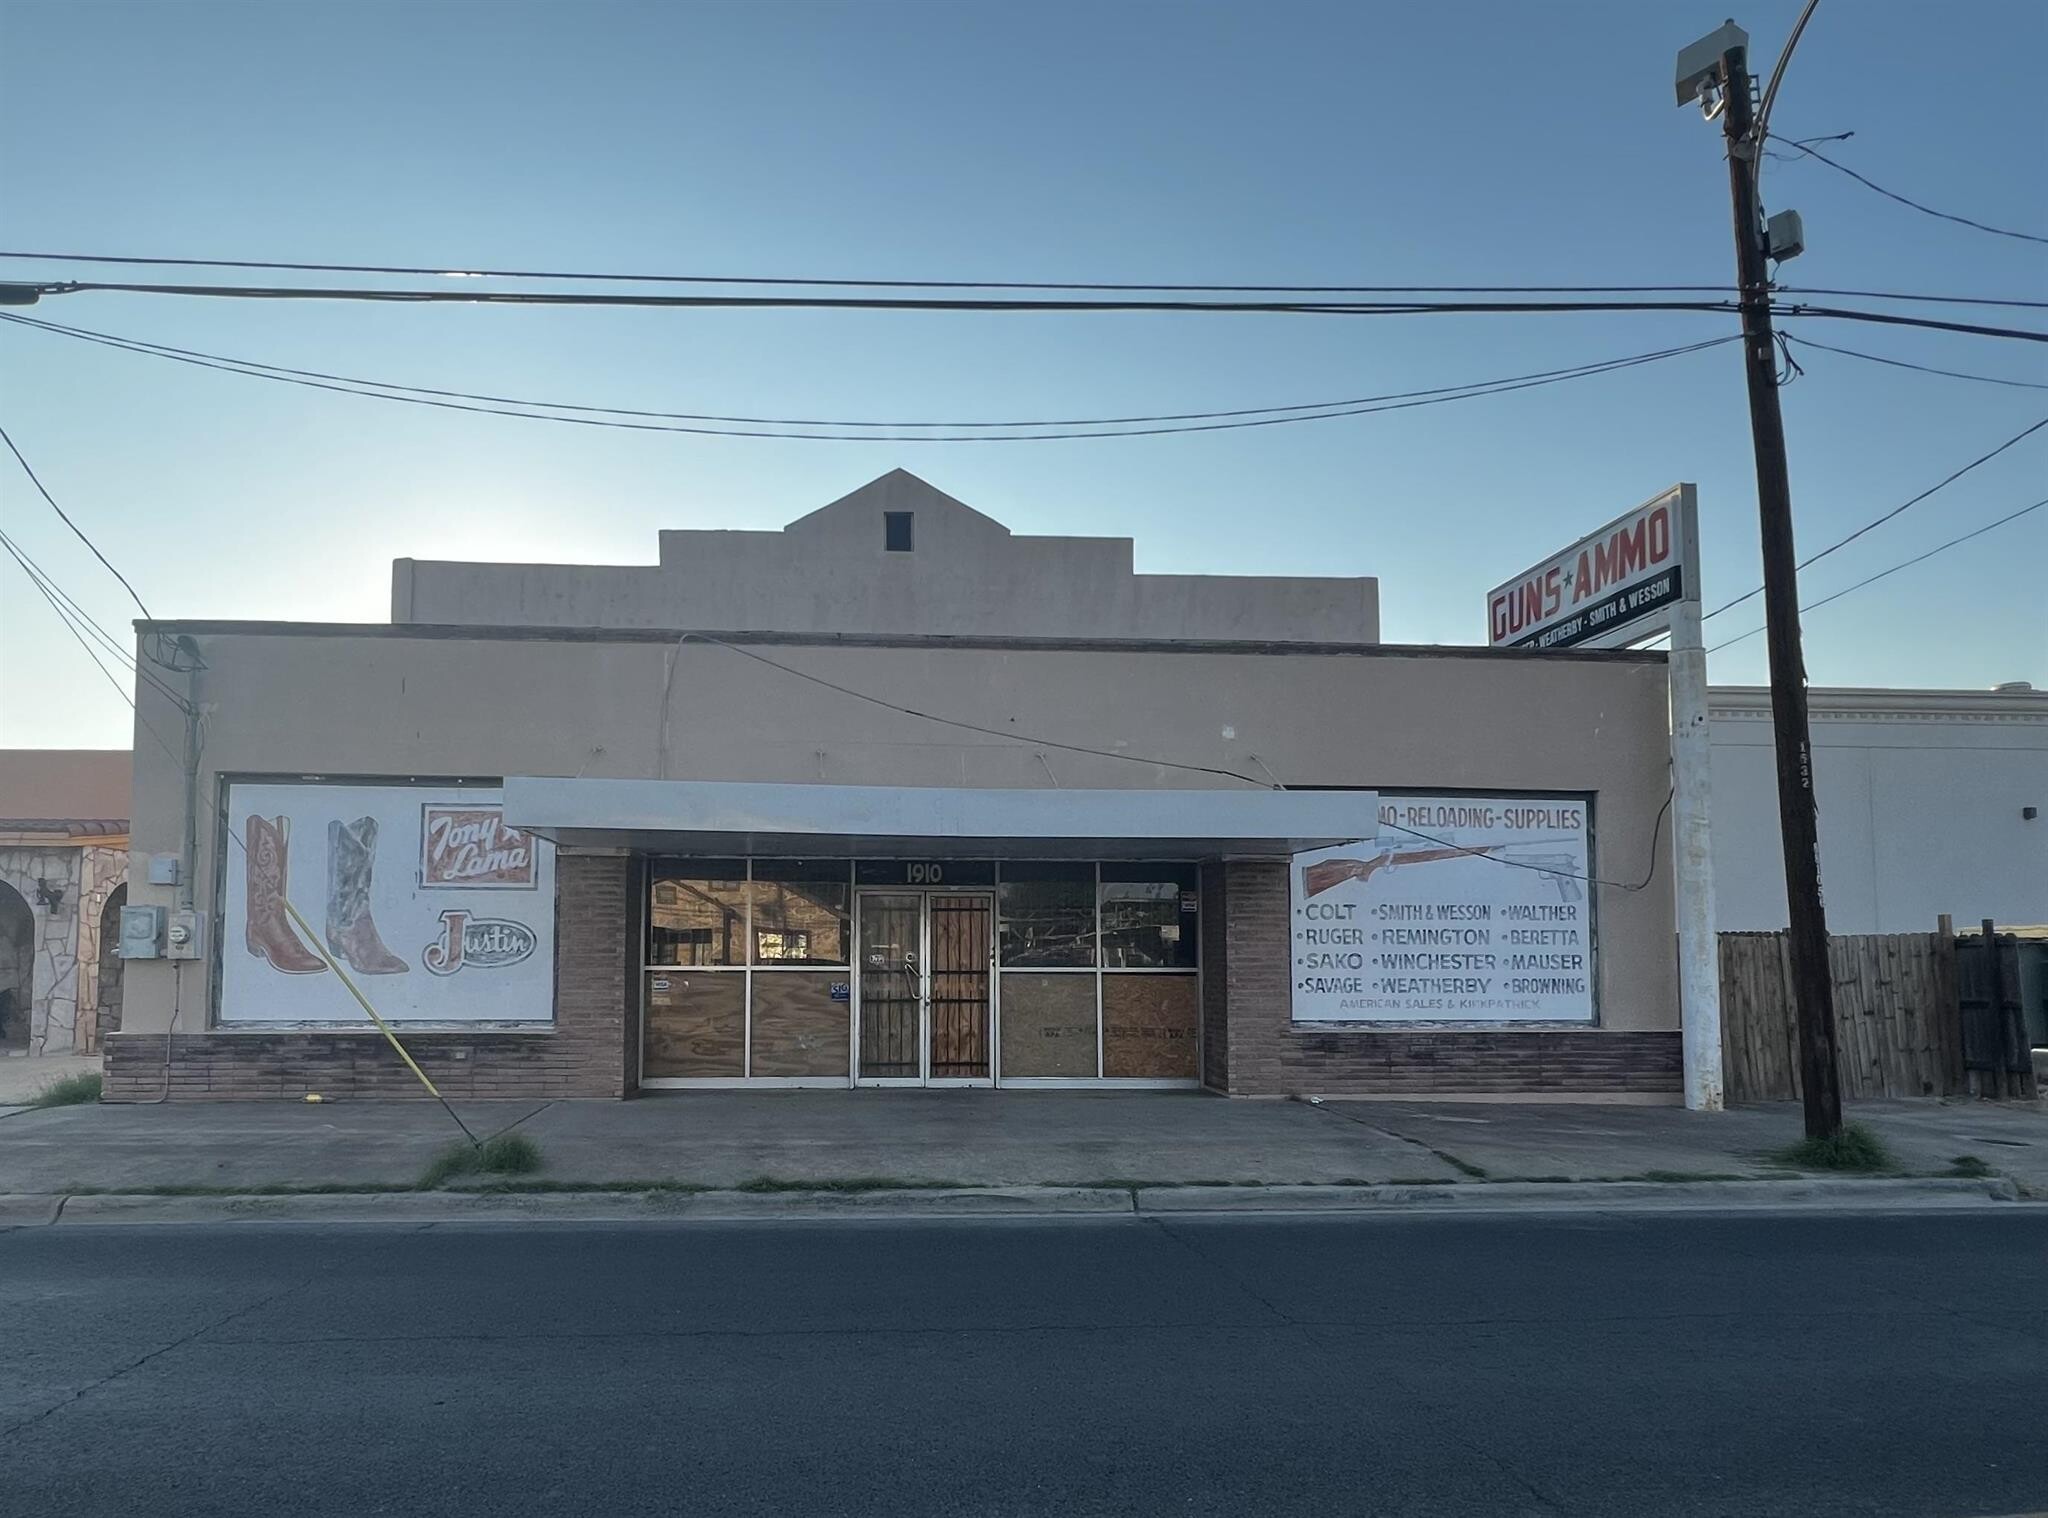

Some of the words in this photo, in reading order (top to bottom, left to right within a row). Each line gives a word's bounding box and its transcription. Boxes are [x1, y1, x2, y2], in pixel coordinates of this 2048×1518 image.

[1492, 566, 1561, 642] GUNS
[1572, 507, 1669, 604] AMMO
[1539, 616, 1583, 648] WEATHERBY
[1589, 601, 1617, 626] SMITH
[1618, 597, 1627, 613] &
[1628, 577, 1670, 609] WESSON
[430, 816, 499, 865] Tony
[443, 843, 529, 880] Lama
[907, 863, 942, 883] 1910
[1305, 904, 1357, 920] COLT
[1379, 904, 1422, 920] SMITH
[1425, 905, 1434, 920] &
[1437, 905, 1491, 920] WESSON
[1508, 905, 1577, 921] WALTHER
[423, 910, 529, 976] Justin
[1306, 928, 1363, 945] RUGER
[1382, 929, 1490, 945] REMINGTON
[1511, 930, 1579, 946] BERETTA
[1306, 953, 1363, 969] SAKO
[1381, 953, 1496, 970] WINCHESTER
[1511, 954, 1583, 970] MAUSER
[1305, 977, 1363, 993] SAVAGE
[1381, 978, 1492, 994] WEATHERBY
[1512, 978, 1585, 994] BROWNING
[1339, 999, 1400, 1009] AMERICAN
[1405, 1000, 1443, 1009] SALES
